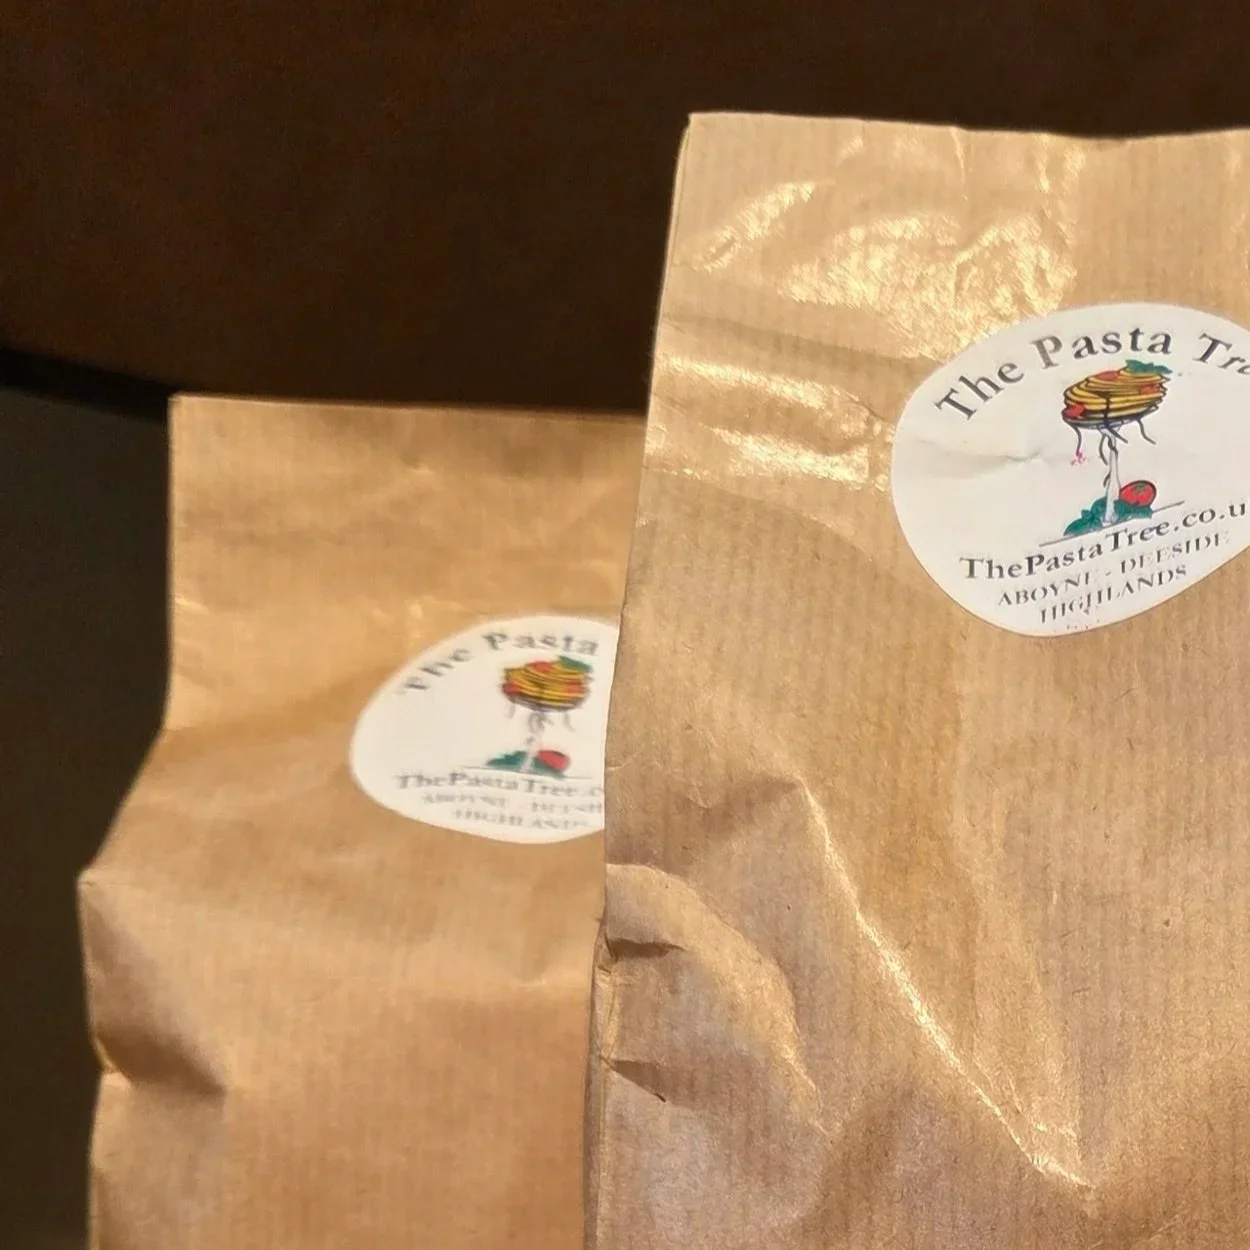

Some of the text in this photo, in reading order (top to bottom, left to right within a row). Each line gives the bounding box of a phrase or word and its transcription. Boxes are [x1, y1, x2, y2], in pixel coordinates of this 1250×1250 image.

[934, 360, 1024, 420] The
[1031, 327, 1173, 370] Pasta
[1040, 564, 1187, 624] HIGHLANDS
[482, 631, 598, 655] Pasta
